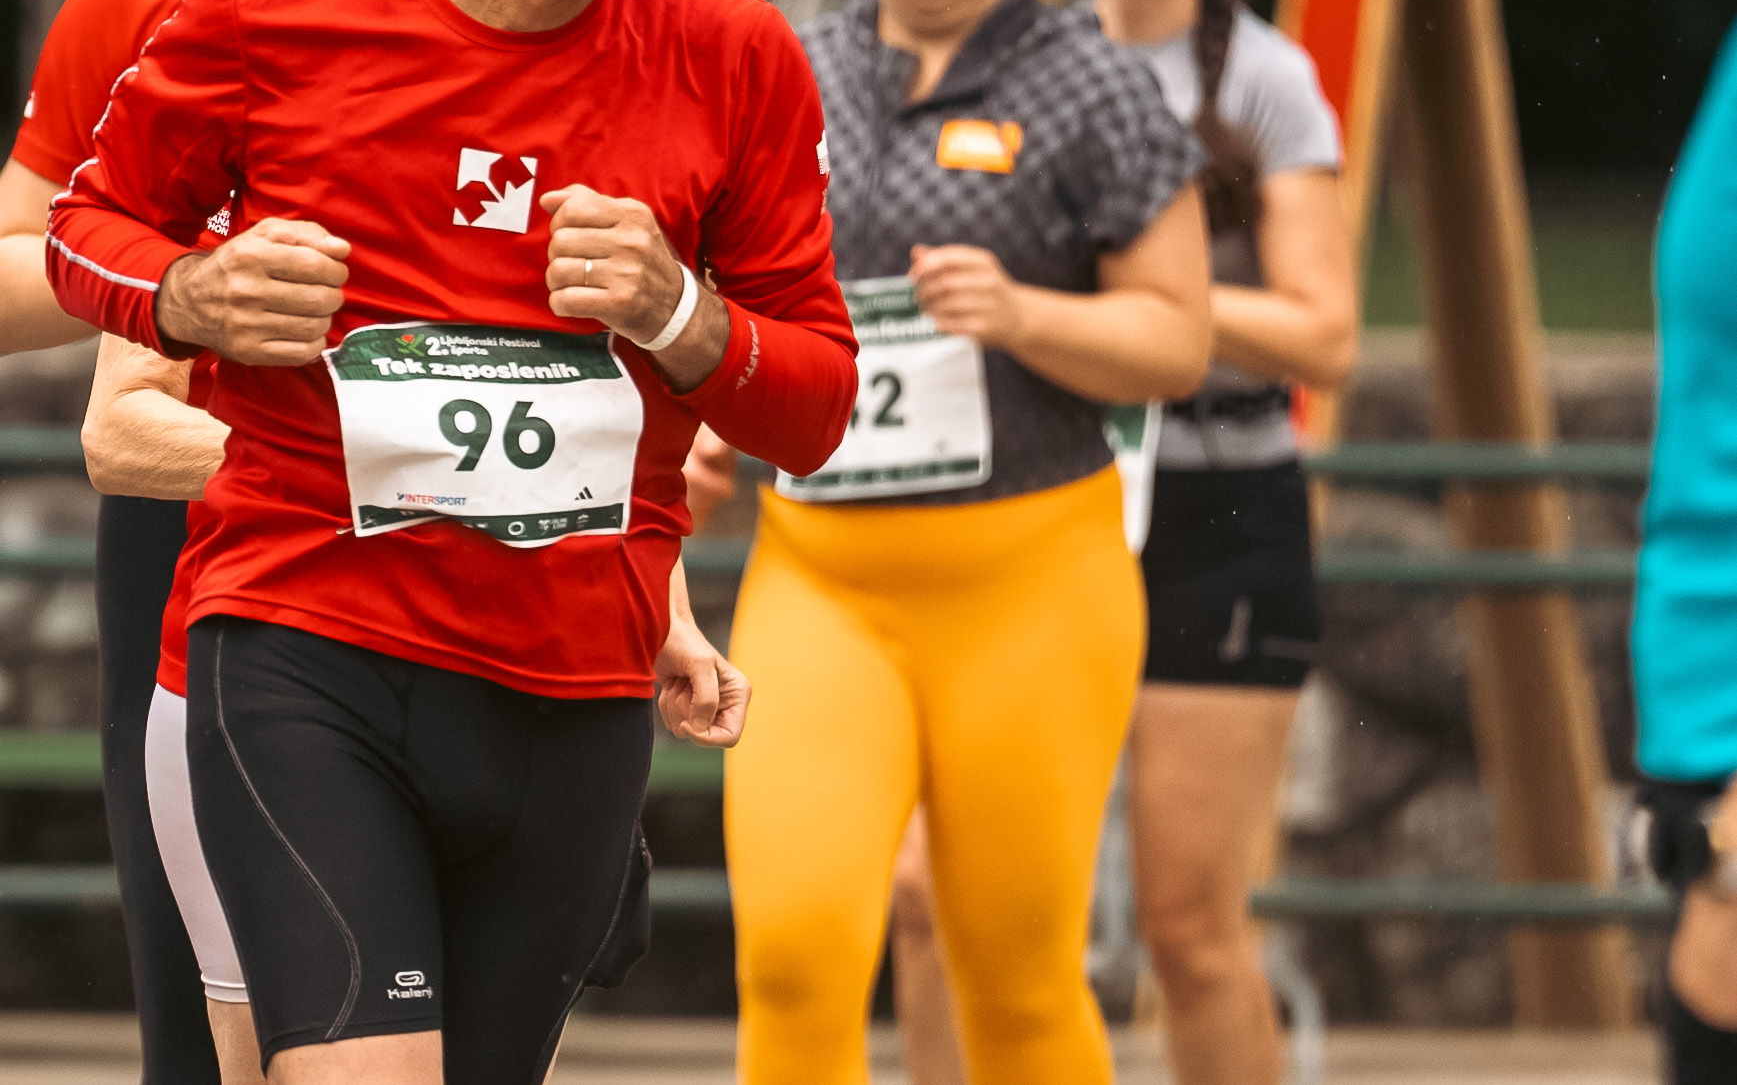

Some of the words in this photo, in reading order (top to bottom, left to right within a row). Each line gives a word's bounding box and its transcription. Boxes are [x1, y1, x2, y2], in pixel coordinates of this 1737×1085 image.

[498, 337, 541, 348] Festival
[371, 357, 427, 376] Tek
[428, 361, 580, 380] zaposlenih
[849, 371, 905, 429] 2
[438, 398, 556, 472] 96
[405, 494, 467, 506] INTERSPORT
